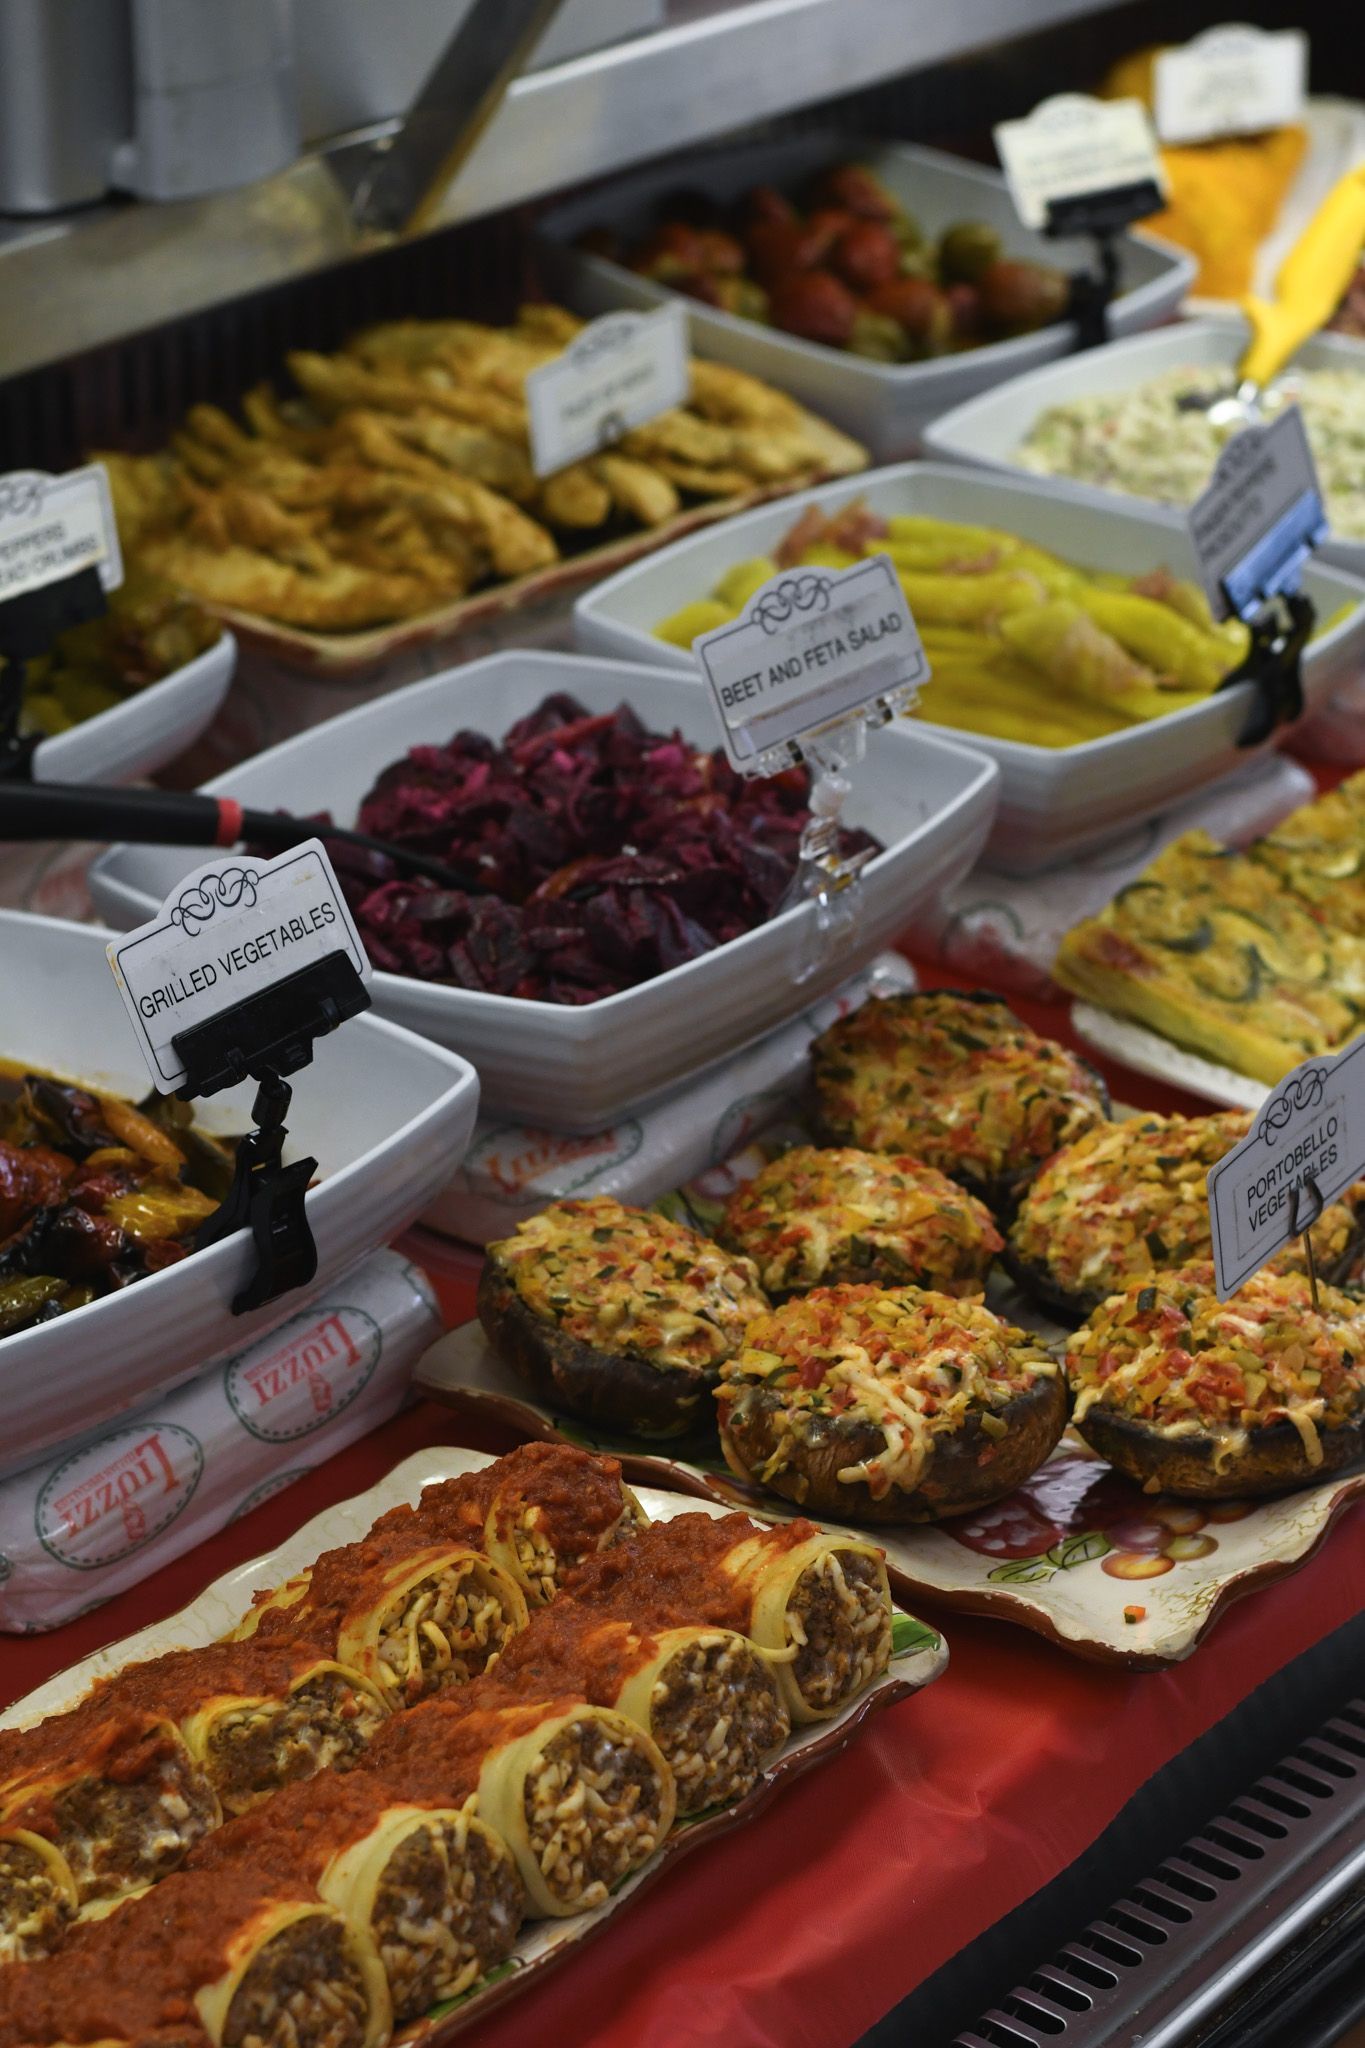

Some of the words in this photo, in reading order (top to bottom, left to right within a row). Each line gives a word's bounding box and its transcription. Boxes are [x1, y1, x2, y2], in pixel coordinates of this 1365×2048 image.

[721, 673, 764, 707] BEET
[769, 658, 801, 688] AND
[804, 639, 847, 670] FETA
[848, 612, 902, 650] SALAD
[139, 963, 218, 1018] GRILLED
[218, 902, 336, 976] VEGETABLES
[1247, 1116, 1338, 1208] PORTOBELLO
